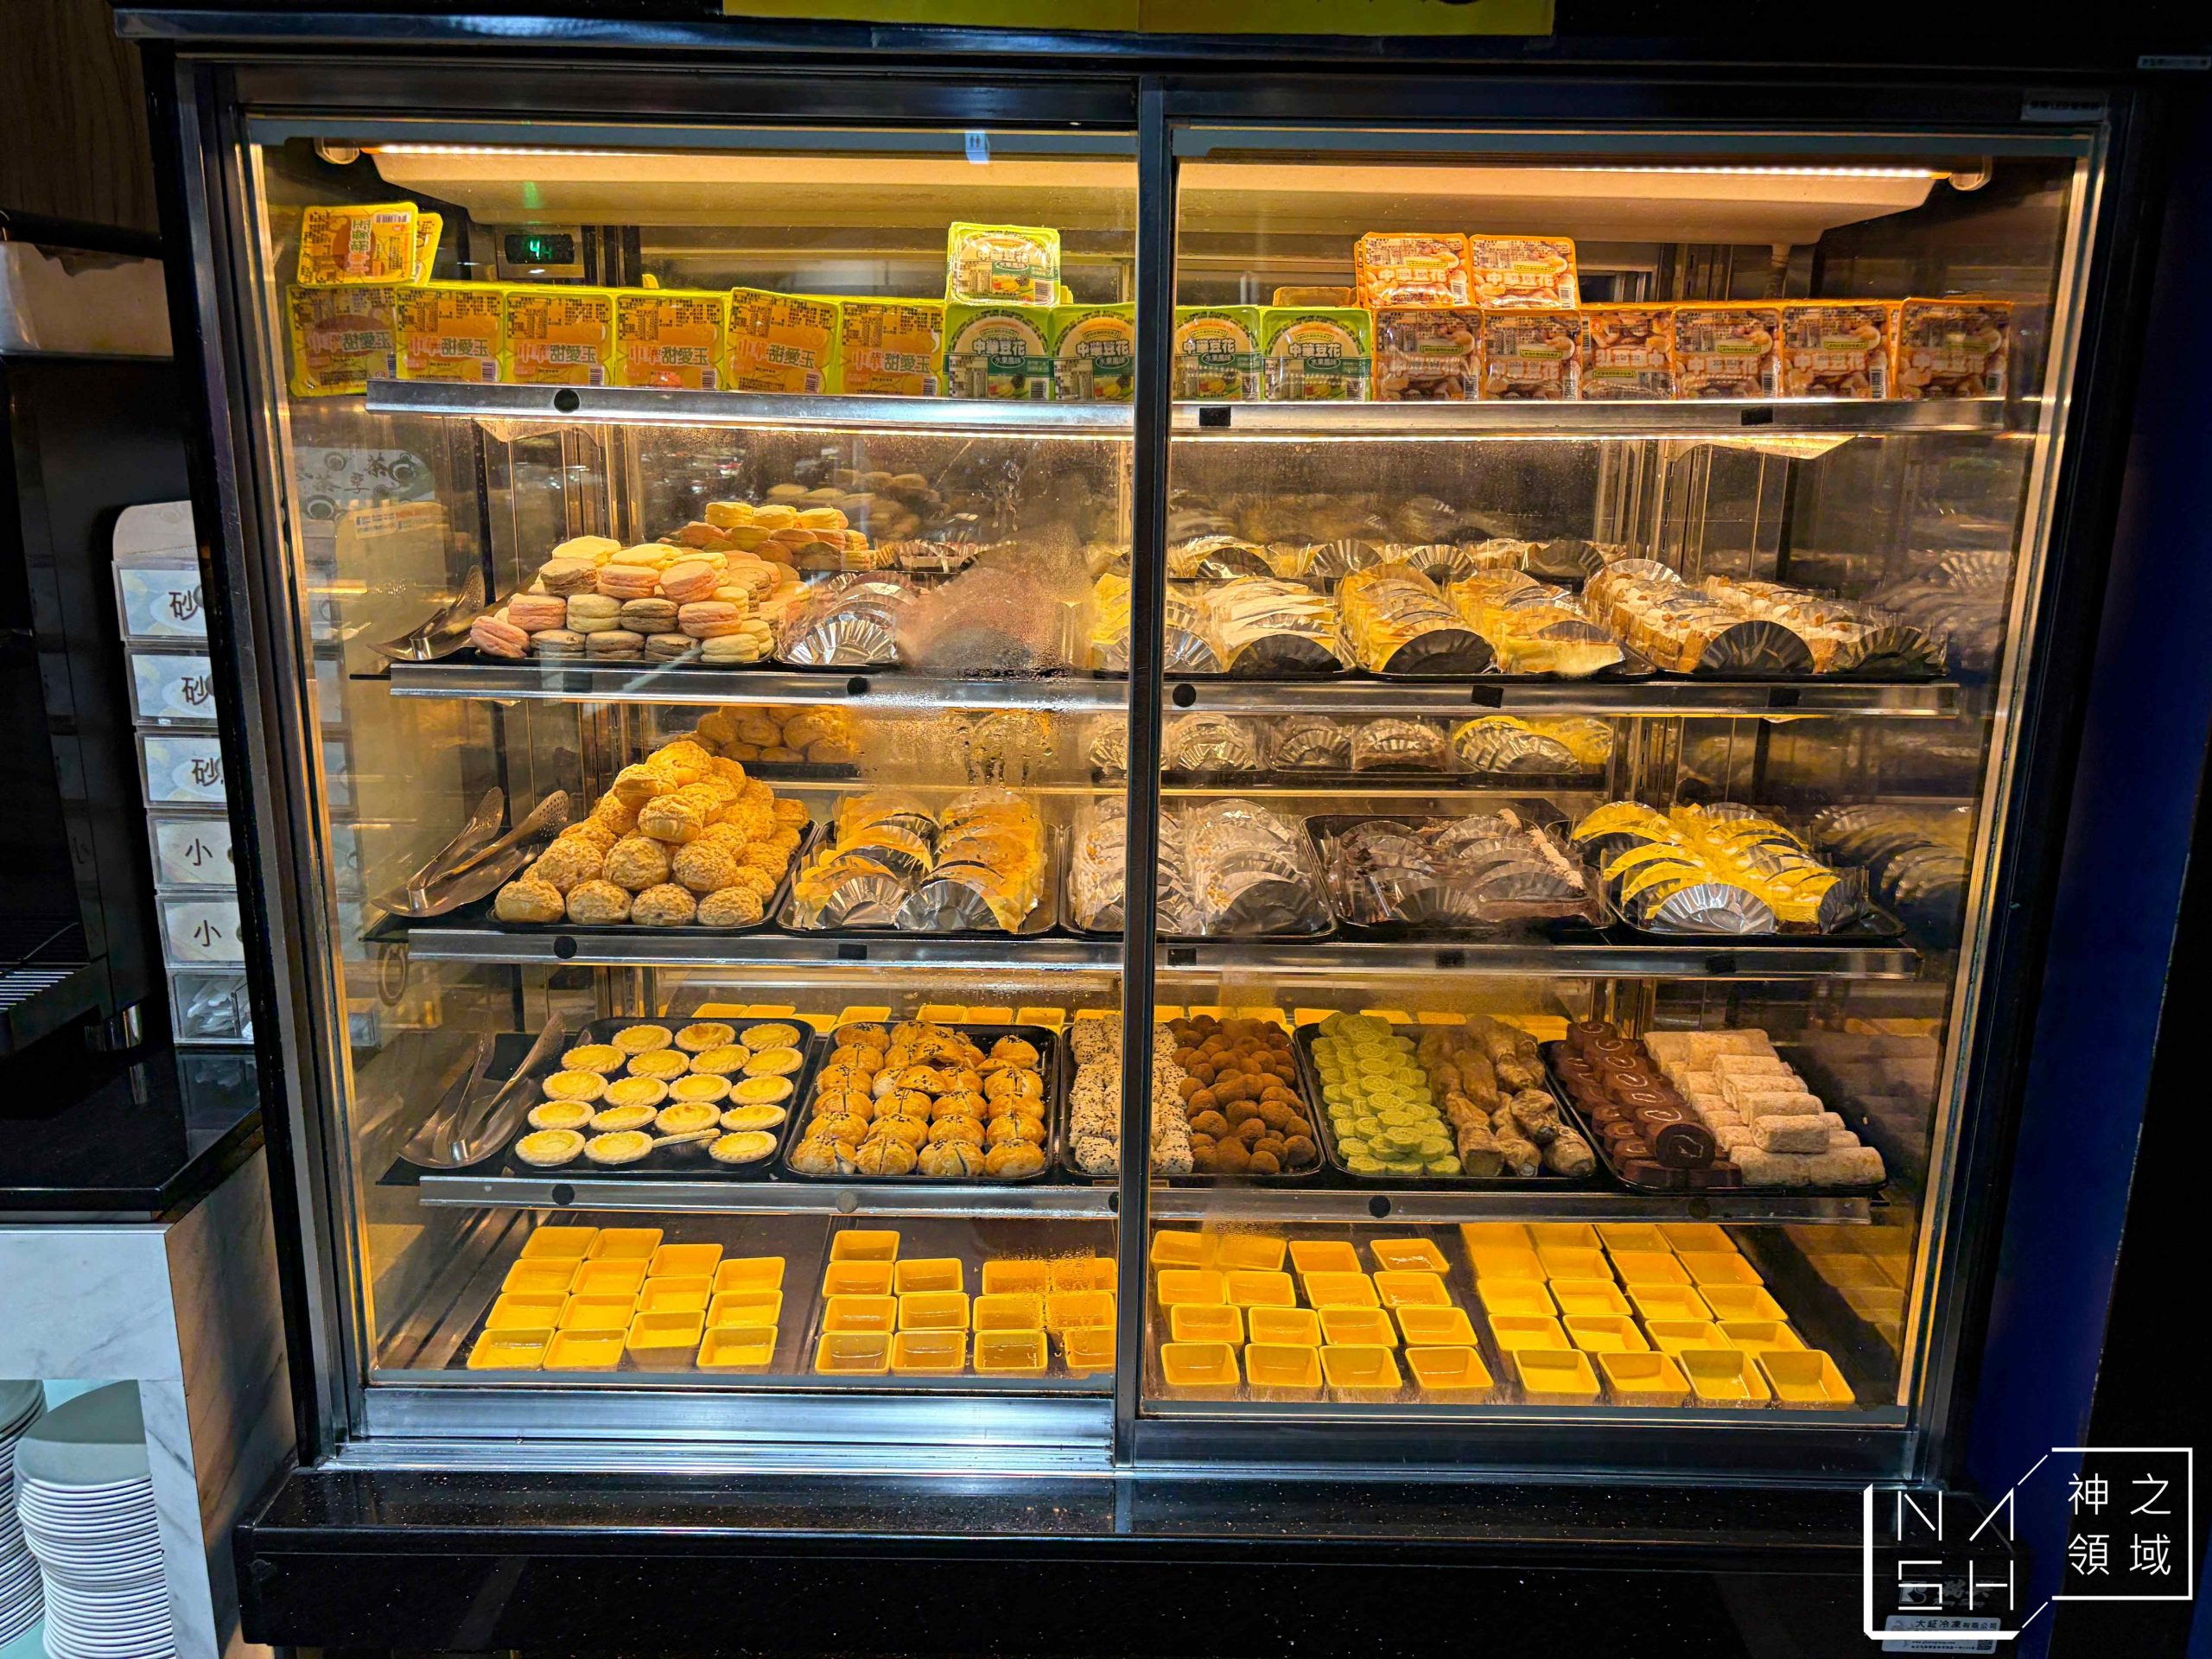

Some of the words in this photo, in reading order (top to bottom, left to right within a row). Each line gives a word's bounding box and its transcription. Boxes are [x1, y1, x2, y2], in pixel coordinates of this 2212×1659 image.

[168, 589, 199, 620] 砂
[181, 675, 209, 706] 砂
[191, 757, 219, 787] 砂
[185, 838, 213, 866] 小
[194, 919, 221, 947] 小
